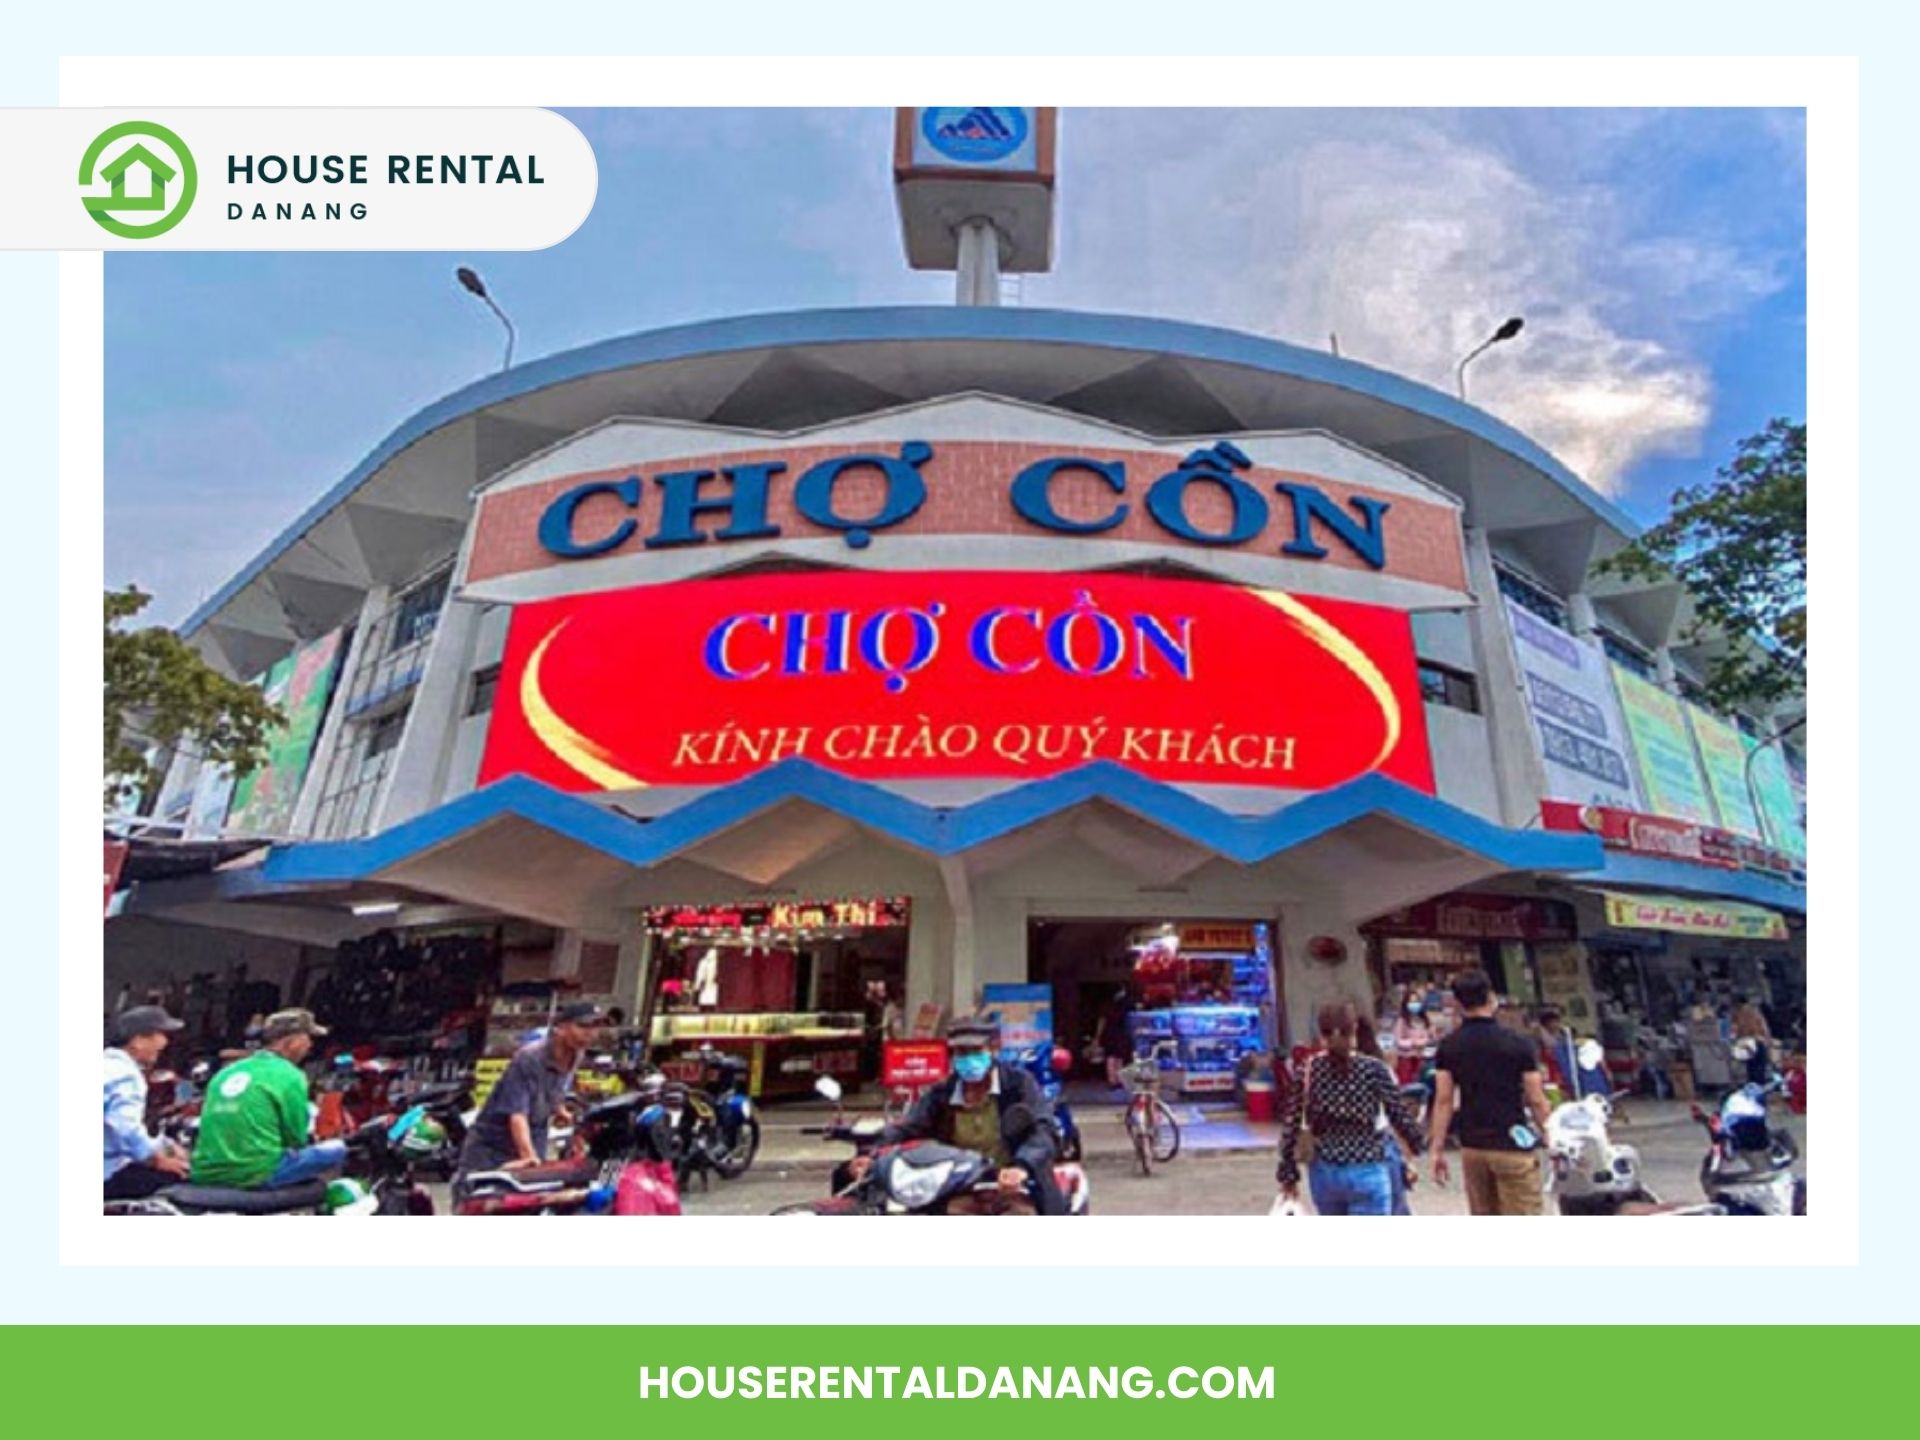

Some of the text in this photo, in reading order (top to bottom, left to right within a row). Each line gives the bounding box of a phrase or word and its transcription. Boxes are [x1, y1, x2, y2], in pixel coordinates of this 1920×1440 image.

[538, 440, 1391, 570] CHỢ CỒN
[703, 588, 1196, 694] CHỢ CỒN
[672, 713, 1297, 770] KÍNH CHÀO QUÝ KHÁCH
